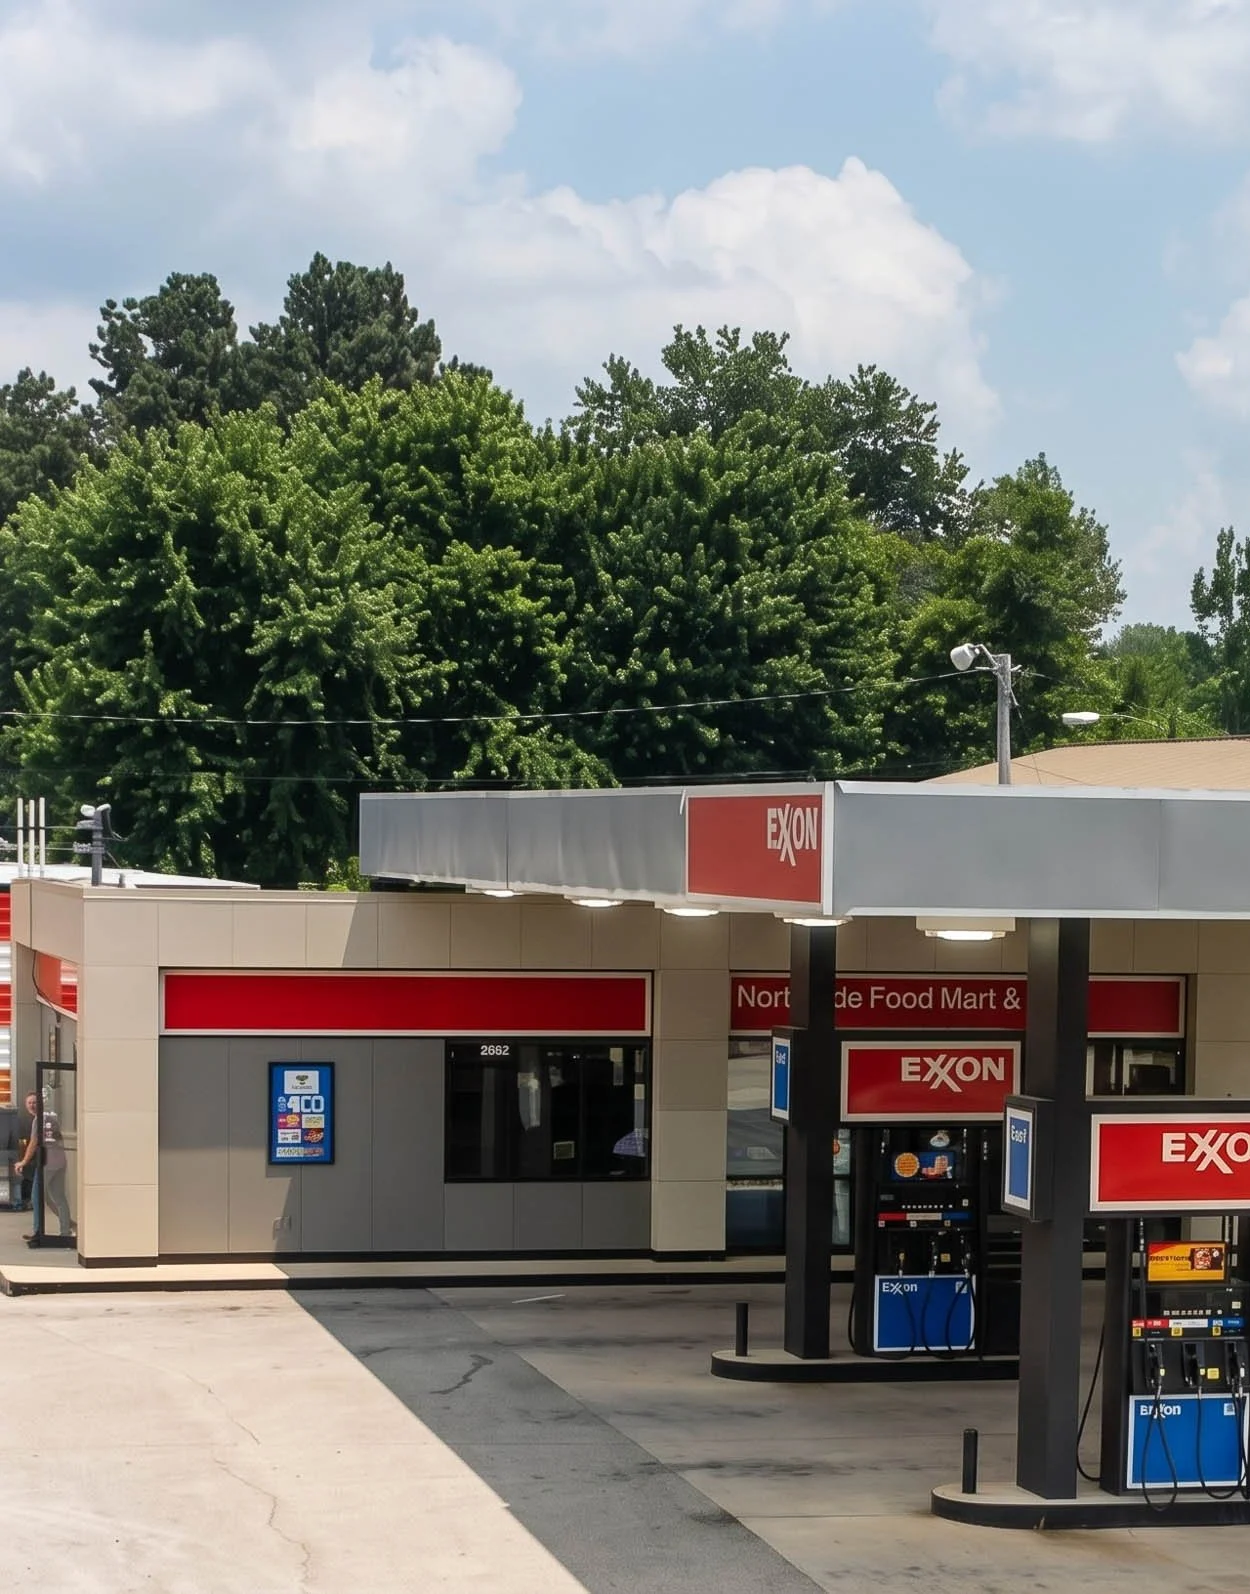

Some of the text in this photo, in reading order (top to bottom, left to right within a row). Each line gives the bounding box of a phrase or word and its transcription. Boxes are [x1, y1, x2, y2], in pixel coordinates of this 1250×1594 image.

[767, 803, 819, 866] EXXON
[737, 985, 1021, 1010] Nortde Food Mart &
[900, 1053, 1006, 1094] EXXON
[882, 1281, 918, 1295] Exxon
